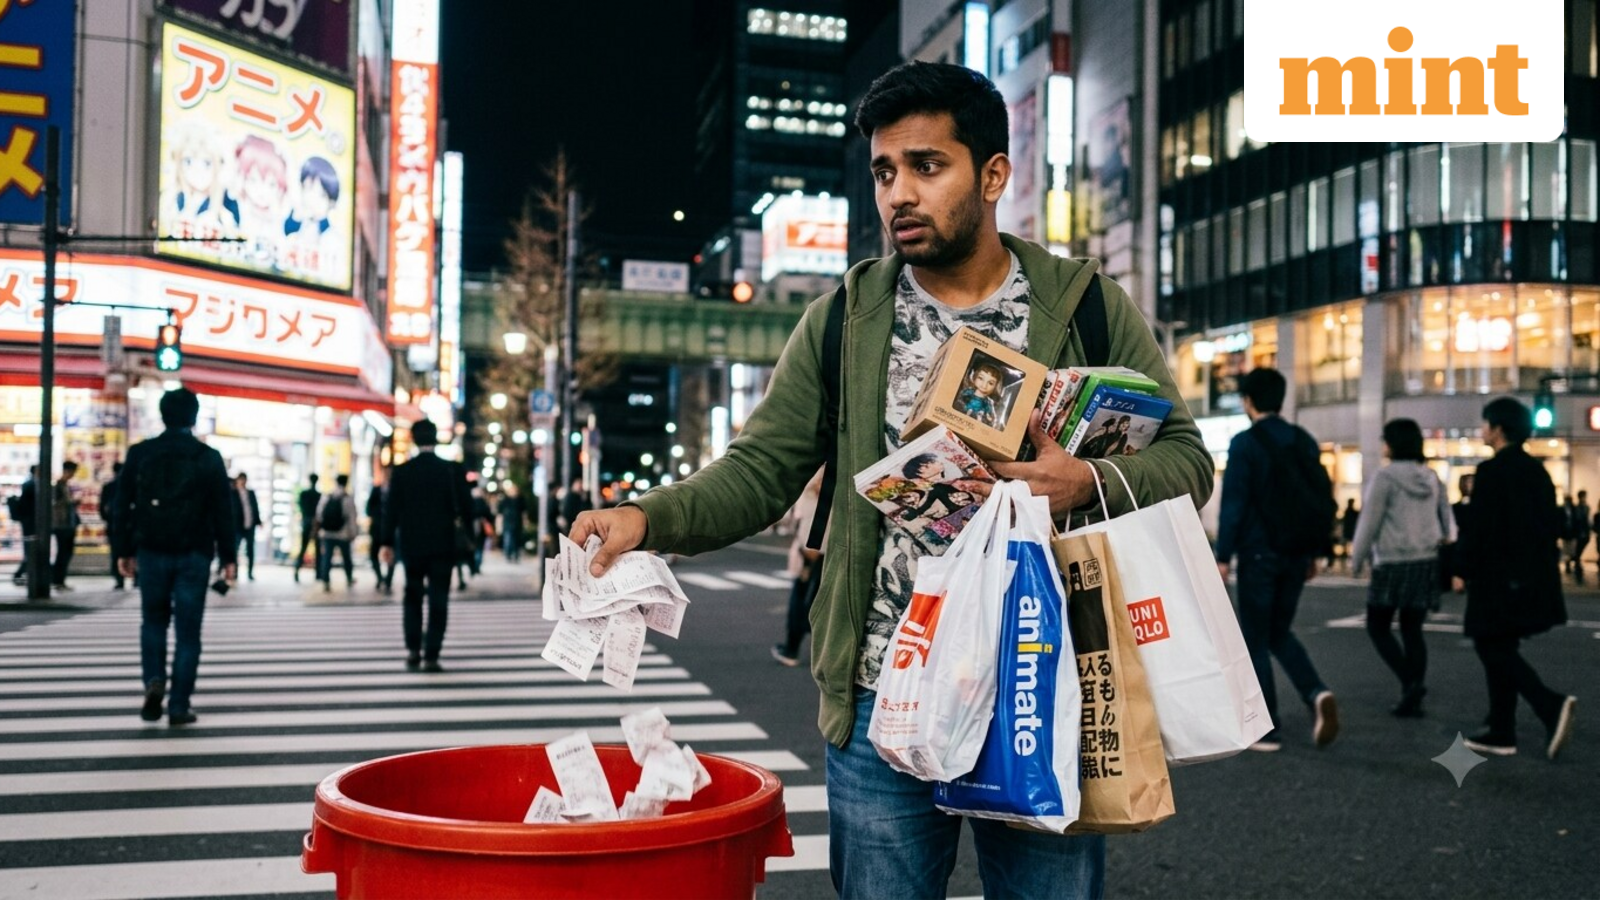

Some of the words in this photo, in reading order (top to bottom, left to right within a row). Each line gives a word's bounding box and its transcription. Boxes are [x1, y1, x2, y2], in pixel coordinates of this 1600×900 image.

[1129, 603, 1158, 623] UNI
[1134, 620, 1164, 641] QLO
[1014, 595, 1053, 757] animate
